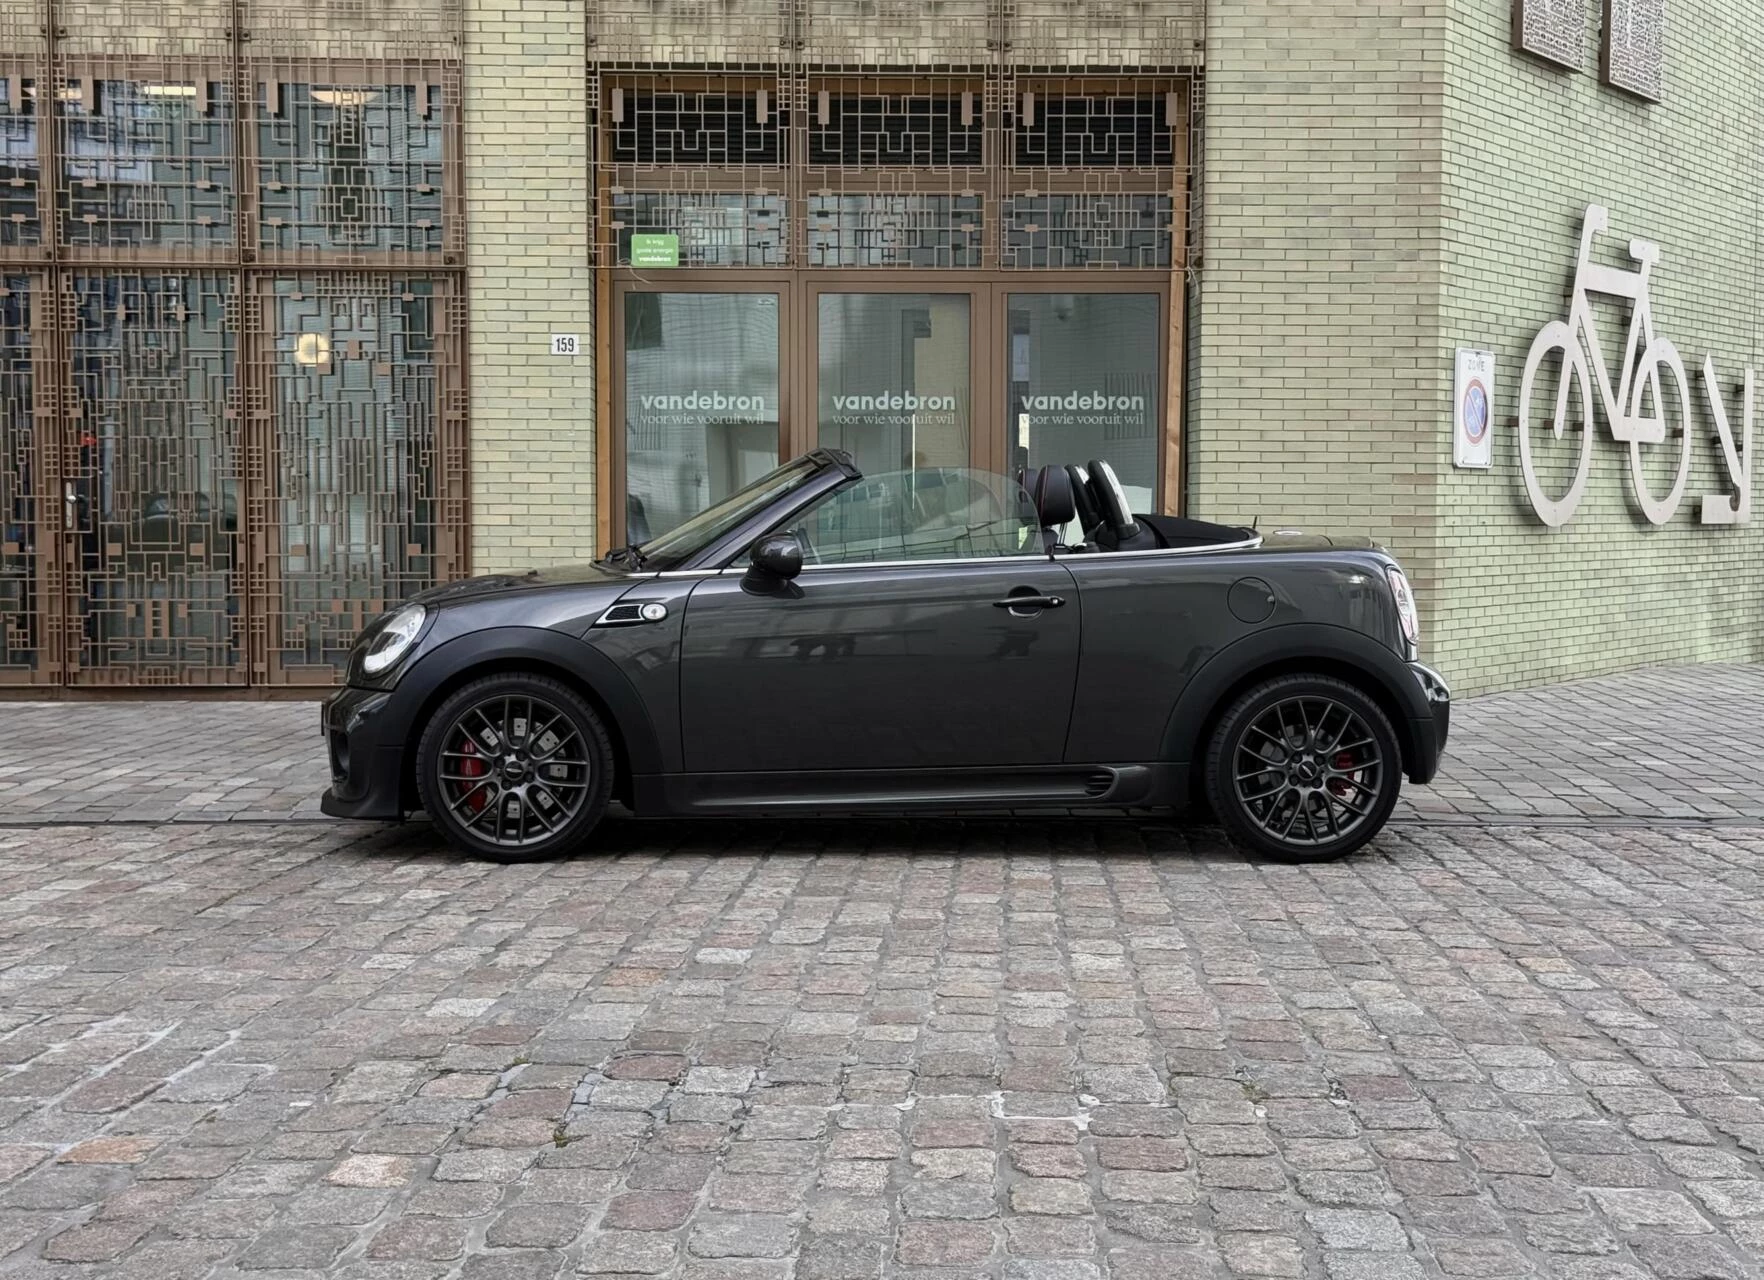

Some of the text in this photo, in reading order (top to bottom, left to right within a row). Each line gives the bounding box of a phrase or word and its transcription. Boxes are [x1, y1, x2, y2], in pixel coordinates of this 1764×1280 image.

[556, 337, 574, 352] 159
[641, 390, 765, 410] vandebron
[832, 390, 956, 410] vandebron
[1021, 390, 1144, 410] vandebron
[641, 413, 764, 424] voor wie vooruit wil
[832, 415, 860, 424] voor
[863, 413, 885, 424] wie
[936, 413, 955, 424] wil
[1051, 413, 1074, 424] wie
[1076, 413, 1121, 424] vooruit
[1124, 413, 1143, 424] wil
